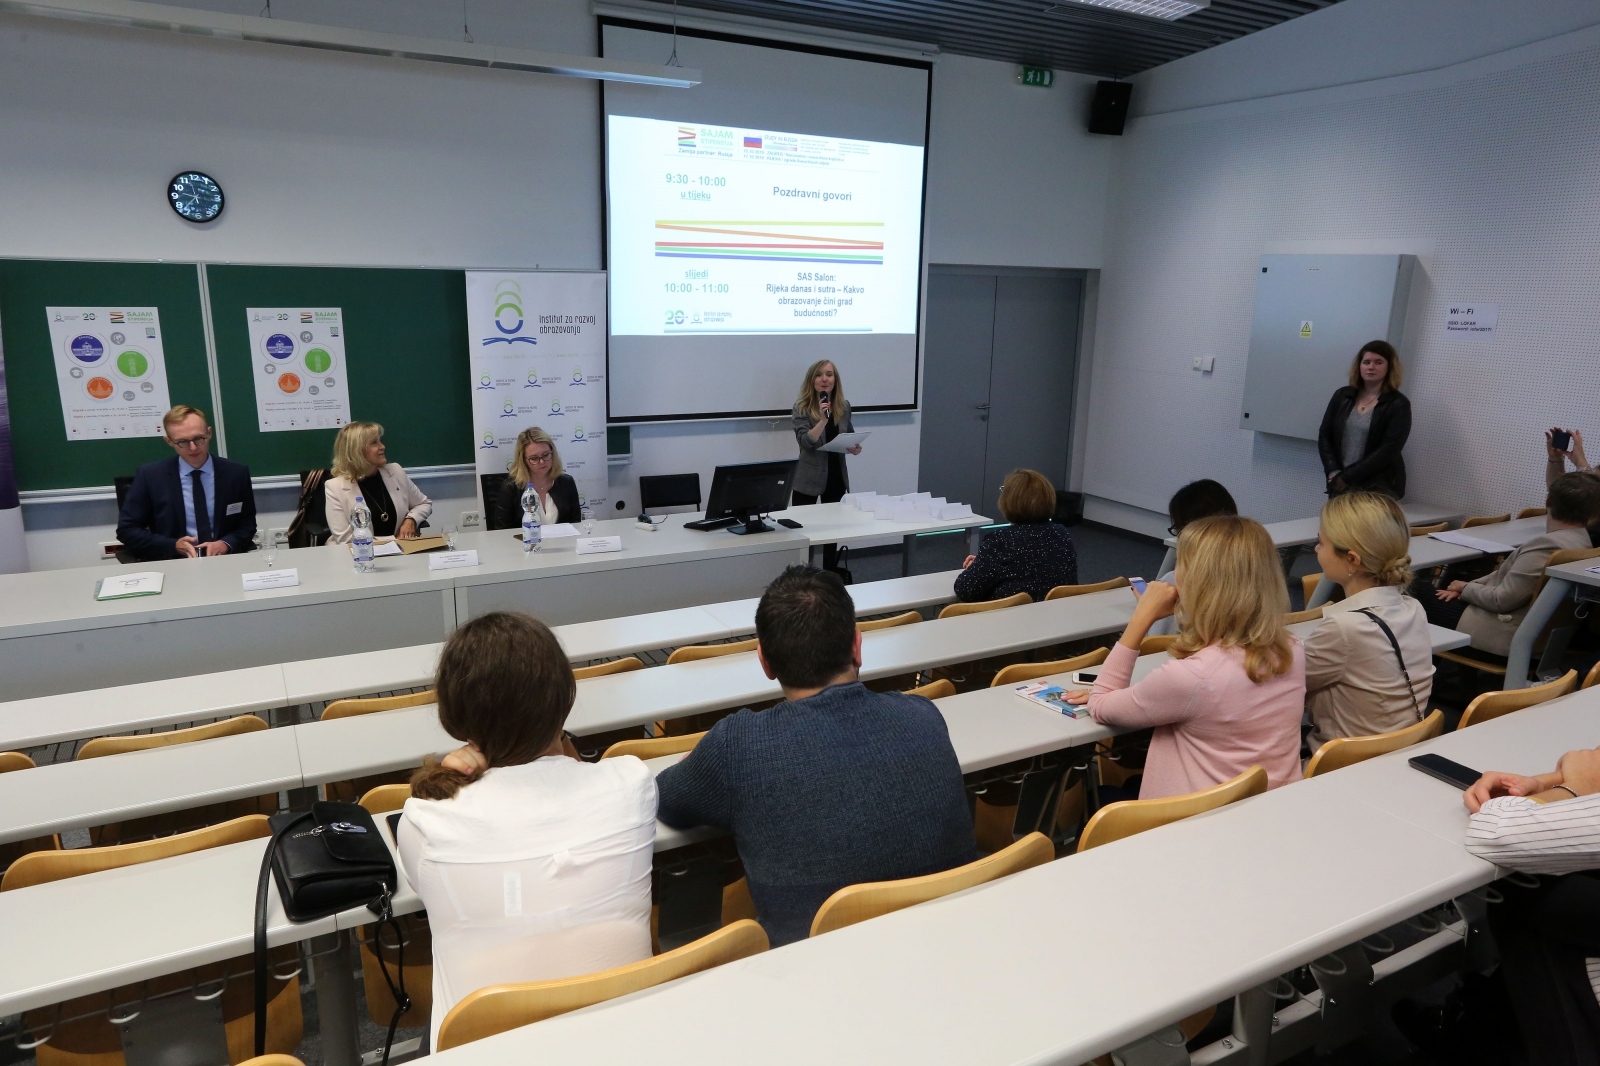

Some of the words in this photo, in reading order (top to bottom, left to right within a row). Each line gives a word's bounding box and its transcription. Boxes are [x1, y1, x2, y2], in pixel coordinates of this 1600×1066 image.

[701, 128, 733, 139] SAJAM
[666, 173, 688, 184] 9:30
[699, 176, 726, 186] 10:00
[688, 191, 711, 200] tijeku
[773, 186, 820, 199] Pozdravni
[823, 192, 852, 201] govori
[685, 269, 708, 278] slijedi
[797, 272, 812, 280] SAS
[814, 273, 836, 281] Salon:
[665, 283, 692, 292] 10:00
[702, 284, 729, 293] 11:00
[766, 284, 788, 294] Rijeka
[778, 296, 821, 306] obrazovanje
[823, 297, 836, 305] čini
[837, 298, 853, 307] grad
[794, 309, 837, 317] budućnosti?
[565, 315, 572, 324] za
[574, 314, 596, 325] razvoj
[540, 325, 581, 335] obrazovanja
